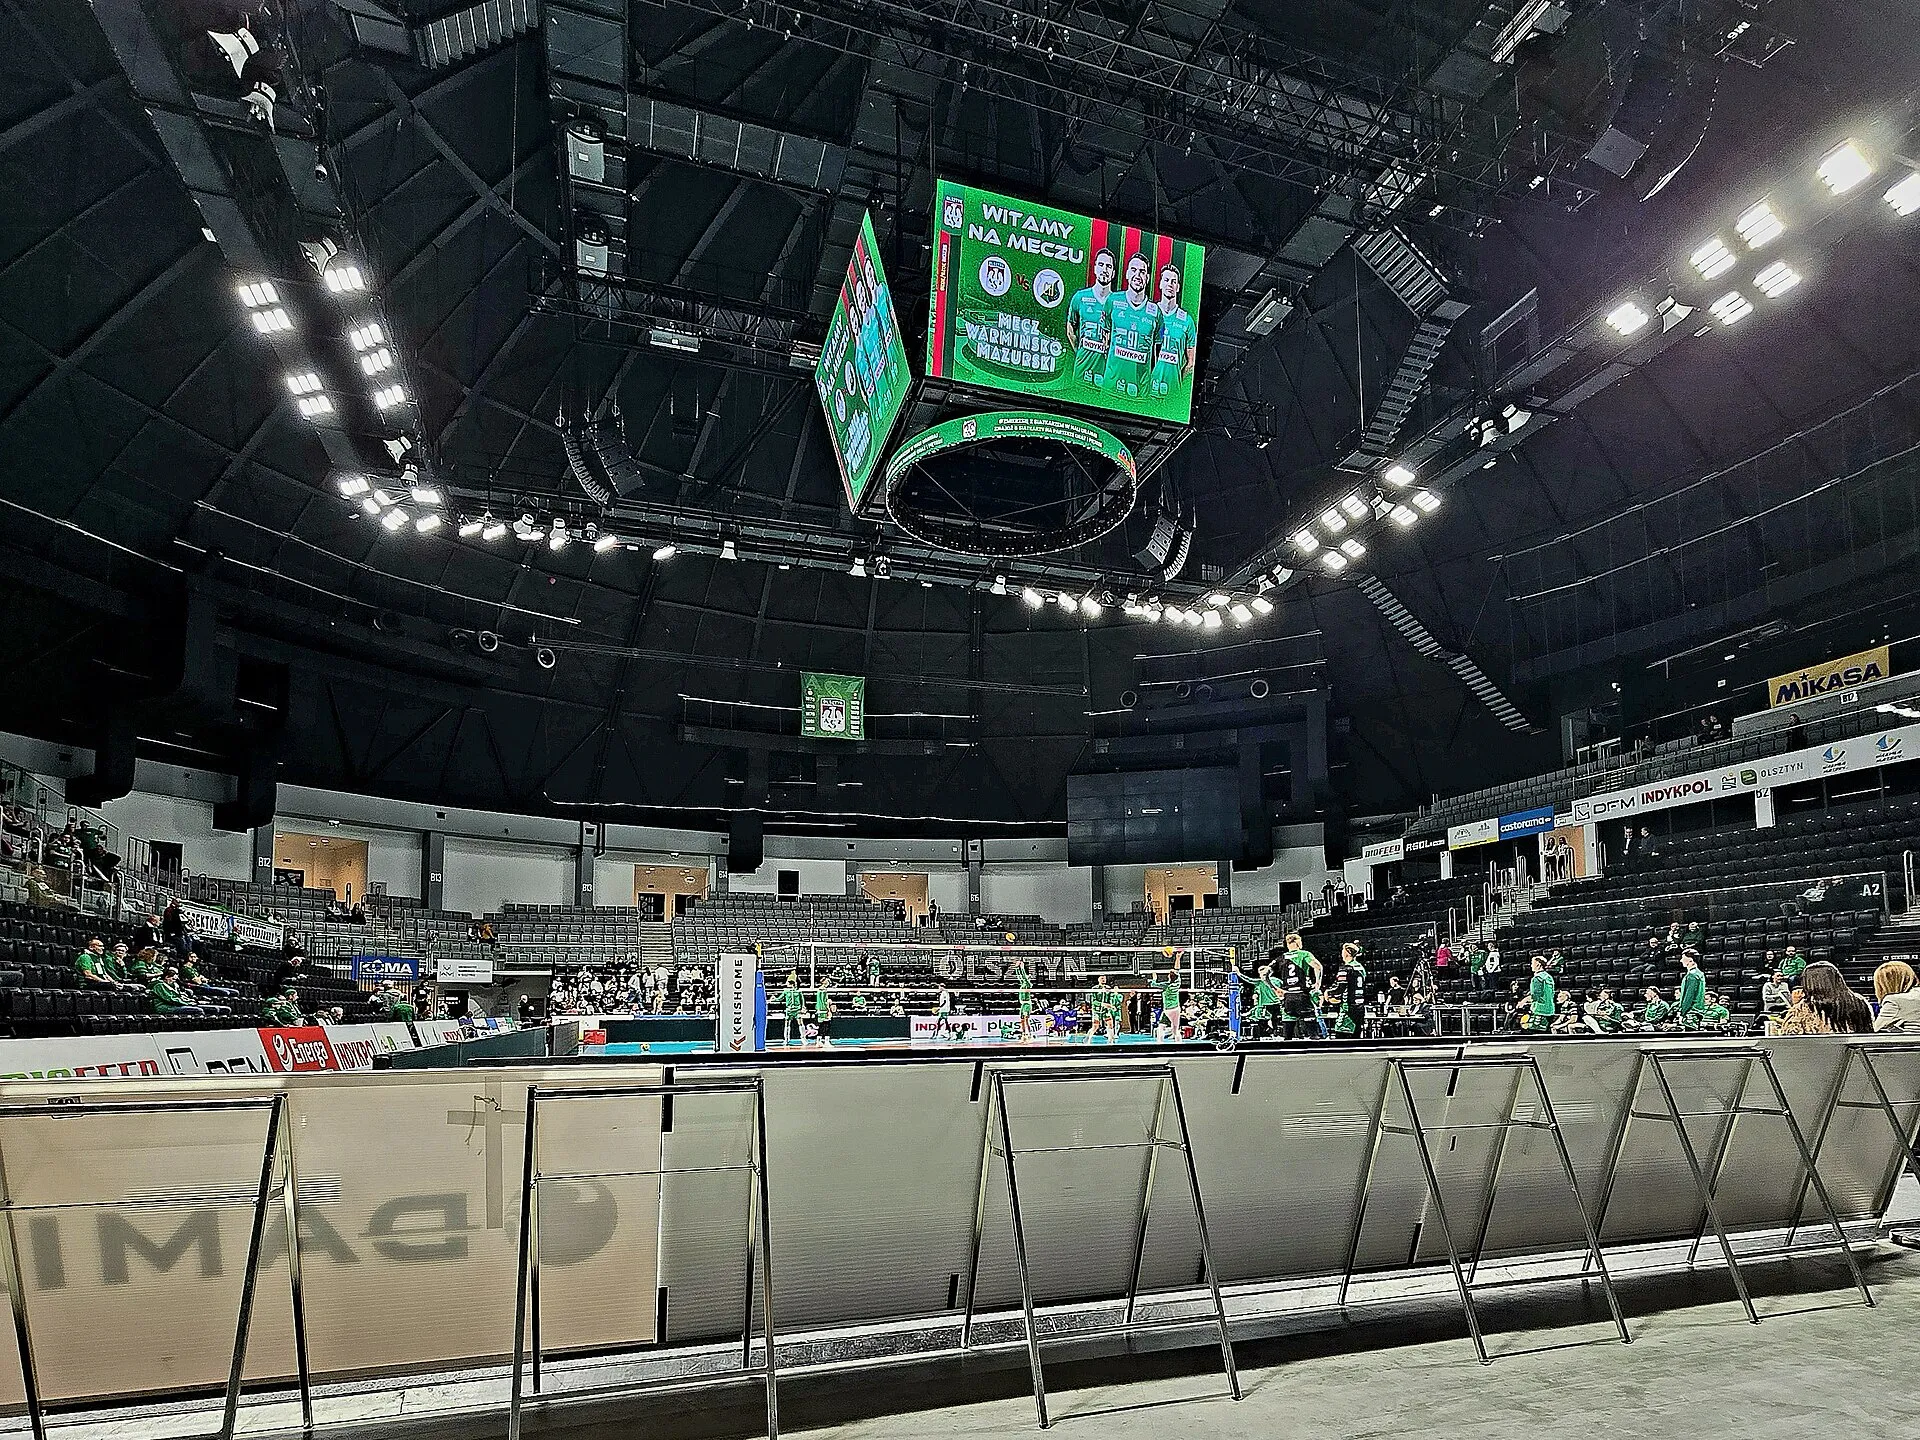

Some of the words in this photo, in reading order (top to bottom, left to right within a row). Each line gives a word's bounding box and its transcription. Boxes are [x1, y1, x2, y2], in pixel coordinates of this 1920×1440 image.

[982, 203, 1074, 240] WITAMY
[968, 223, 1002, 246] NA
[1007, 233, 1084, 264] MECZU
[998, 311, 1040, 336] MECZ
[977, 342, 1056, 373] MAZURSKI
[1775, 662, 1882, 704] MIKASA
[1760, 762, 1804, 778] OLSZTYN
[1641, 779, 1713, 805] INDYKPOL
[1593, 797, 1635, 815] DFM
[1500, 817, 1545, 833] castorama
[258, 856, 271, 868] B12
[430, 872, 442, 884] B13
[1861, 883, 1881, 897] A2
[933, 953, 1088, 981] OLSZTYN
[1287, 964, 1296, 977] 2
[733, 959, 743, 1035] KRISHOME
[987, 1019, 1021, 1034] plus
[288, 1039, 329, 1068] Energa
